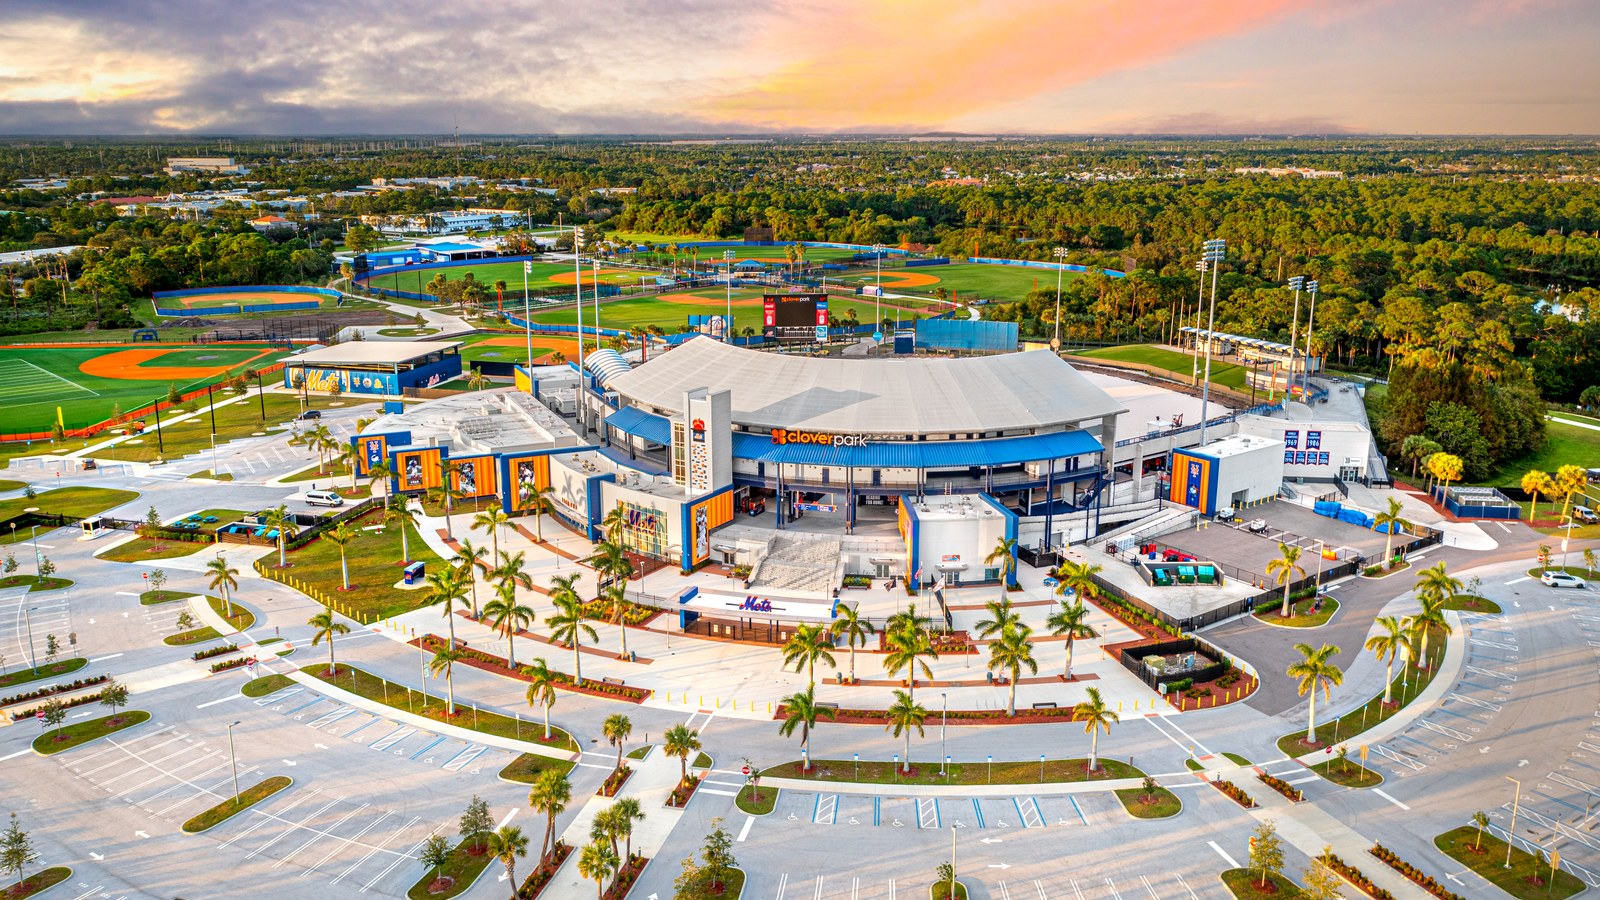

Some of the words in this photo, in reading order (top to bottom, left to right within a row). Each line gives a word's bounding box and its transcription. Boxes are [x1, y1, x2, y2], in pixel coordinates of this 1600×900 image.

[787, 430, 833, 444] clover
[833, 433, 867, 448] park
[739, 595, 771, 612] Mets
